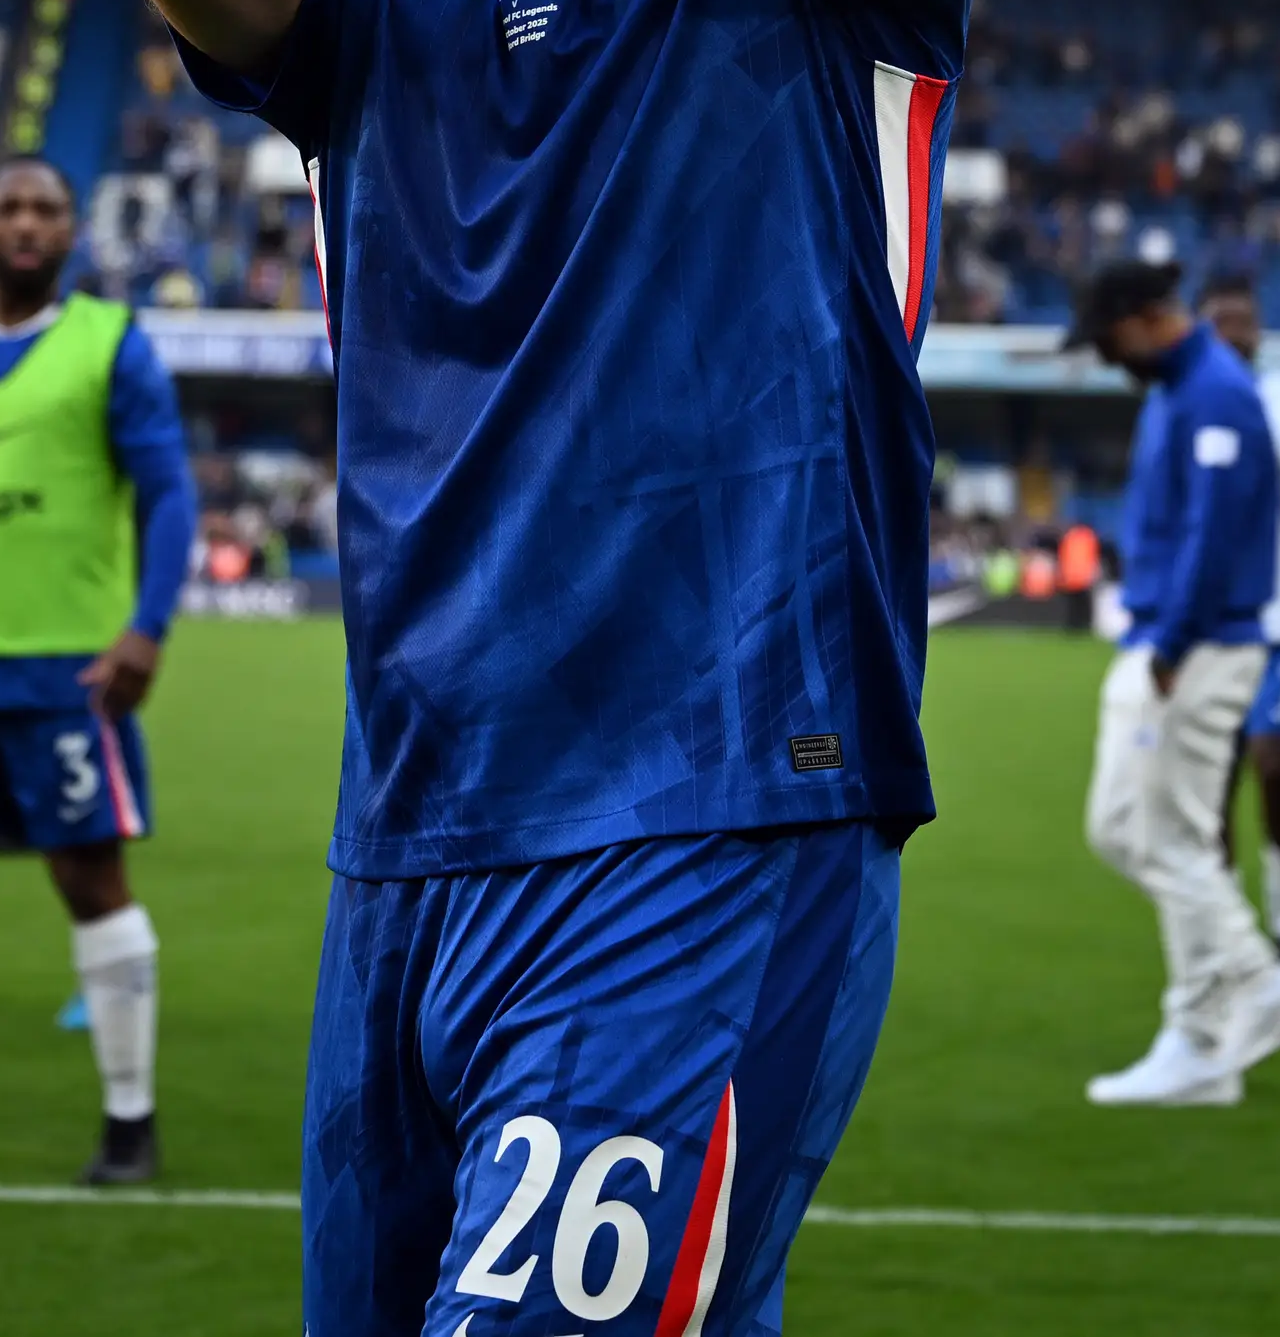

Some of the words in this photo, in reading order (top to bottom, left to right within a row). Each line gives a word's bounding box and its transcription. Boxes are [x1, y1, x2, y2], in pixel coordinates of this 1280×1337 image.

[512, 11, 521, 20] FC
[522, 3, 558, 16] Legends
[527, 18, 548, 29] 2025
[520, 31, 545, 44] Bridge
[54, 734, 100, 802] 3
[456, 1116, 664, 1321] 26
